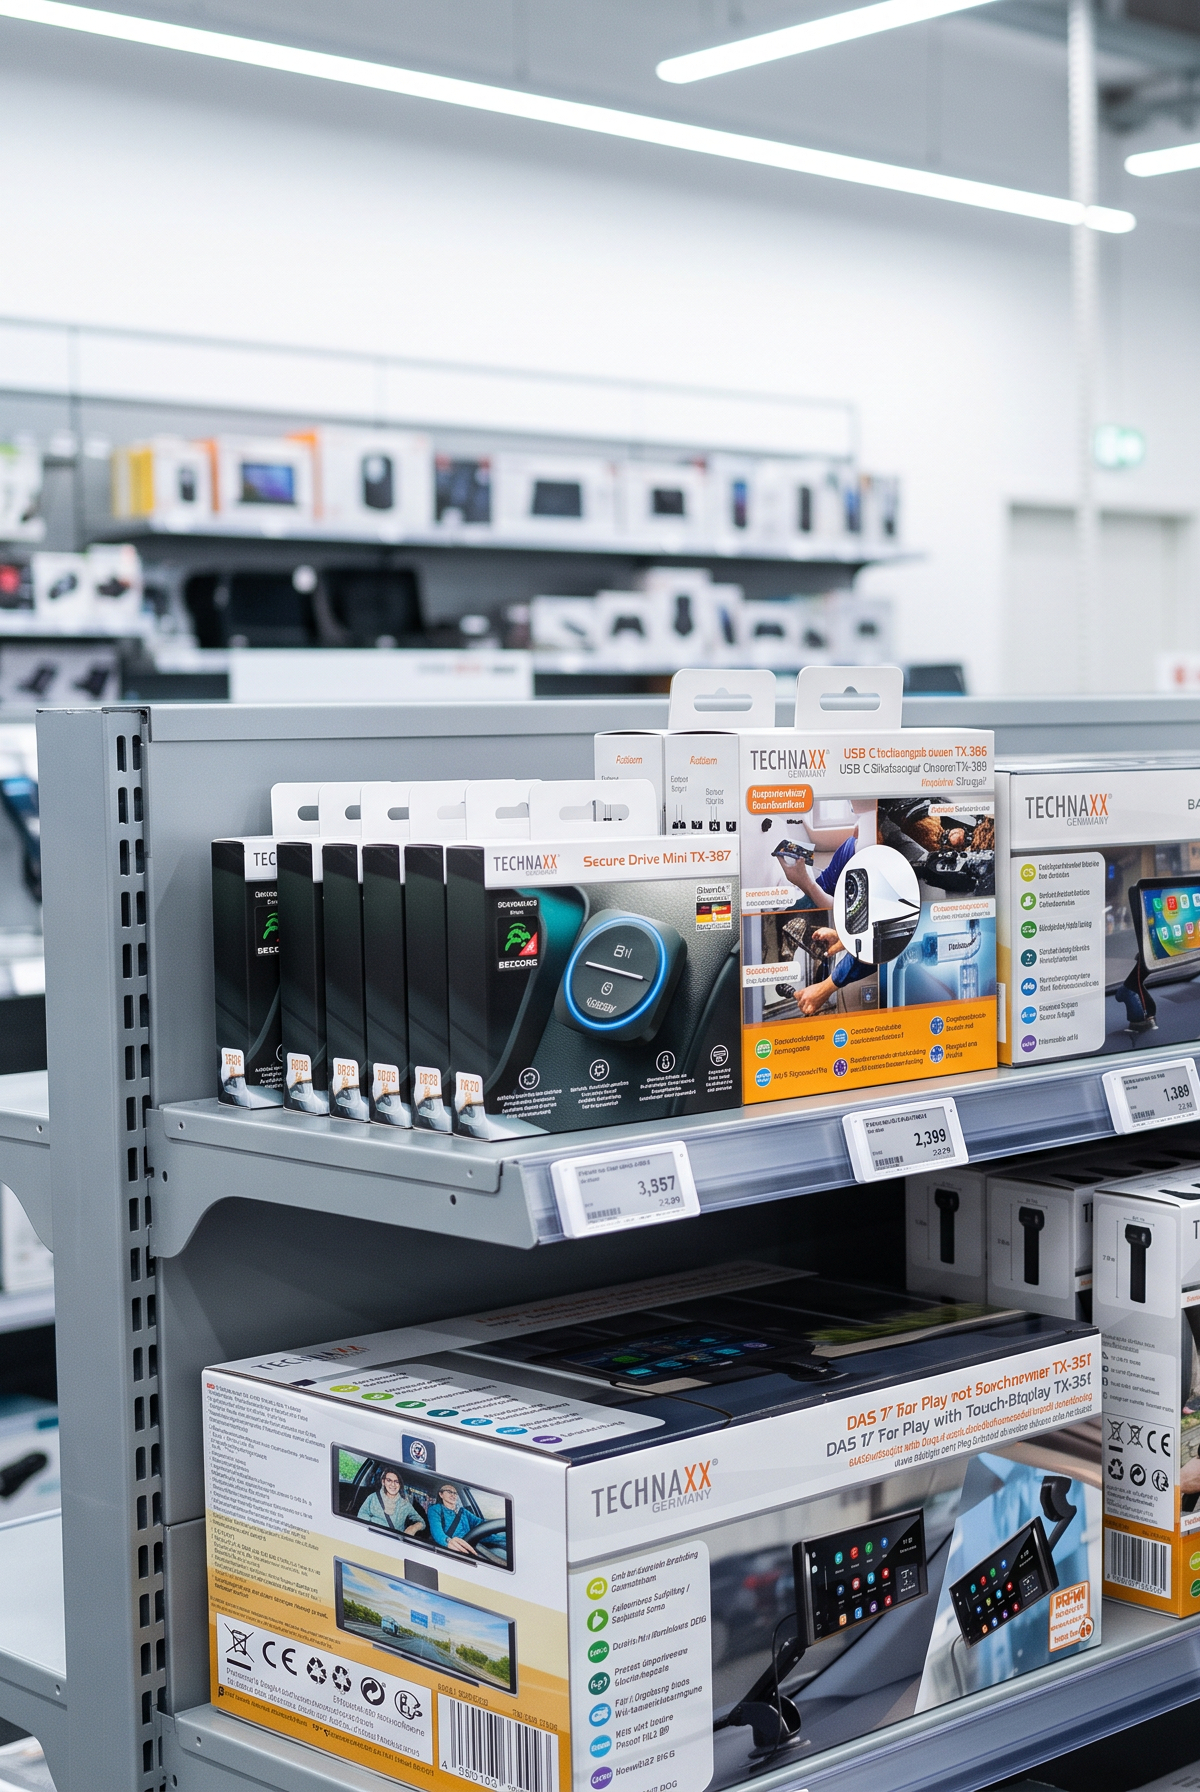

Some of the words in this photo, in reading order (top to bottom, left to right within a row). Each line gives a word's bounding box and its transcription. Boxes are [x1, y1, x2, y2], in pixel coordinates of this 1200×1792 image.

[843, 748, 866, 760] USB
[839, 763, 861, 774] USB
[583, 855, 626, 868] Secure
[628, 853, 660, 866] Drive
[662, 851, 687, 864] Mini
[690, 850, 732, 863] TX-387
[913, 1128, 947, 1148] 2,399
[847, 1409, 877, 1431] DAS
[921, 1394, 948, 1411] Play
[826, 1435, 857, 1457] DAS
[902, 1419, 930, 1436] Play
[934, 1408, 962, 1428] with
[591, 1460, 712, 1517] TECHNAXX
[652, 1488, 712, 1514] GERMANY
